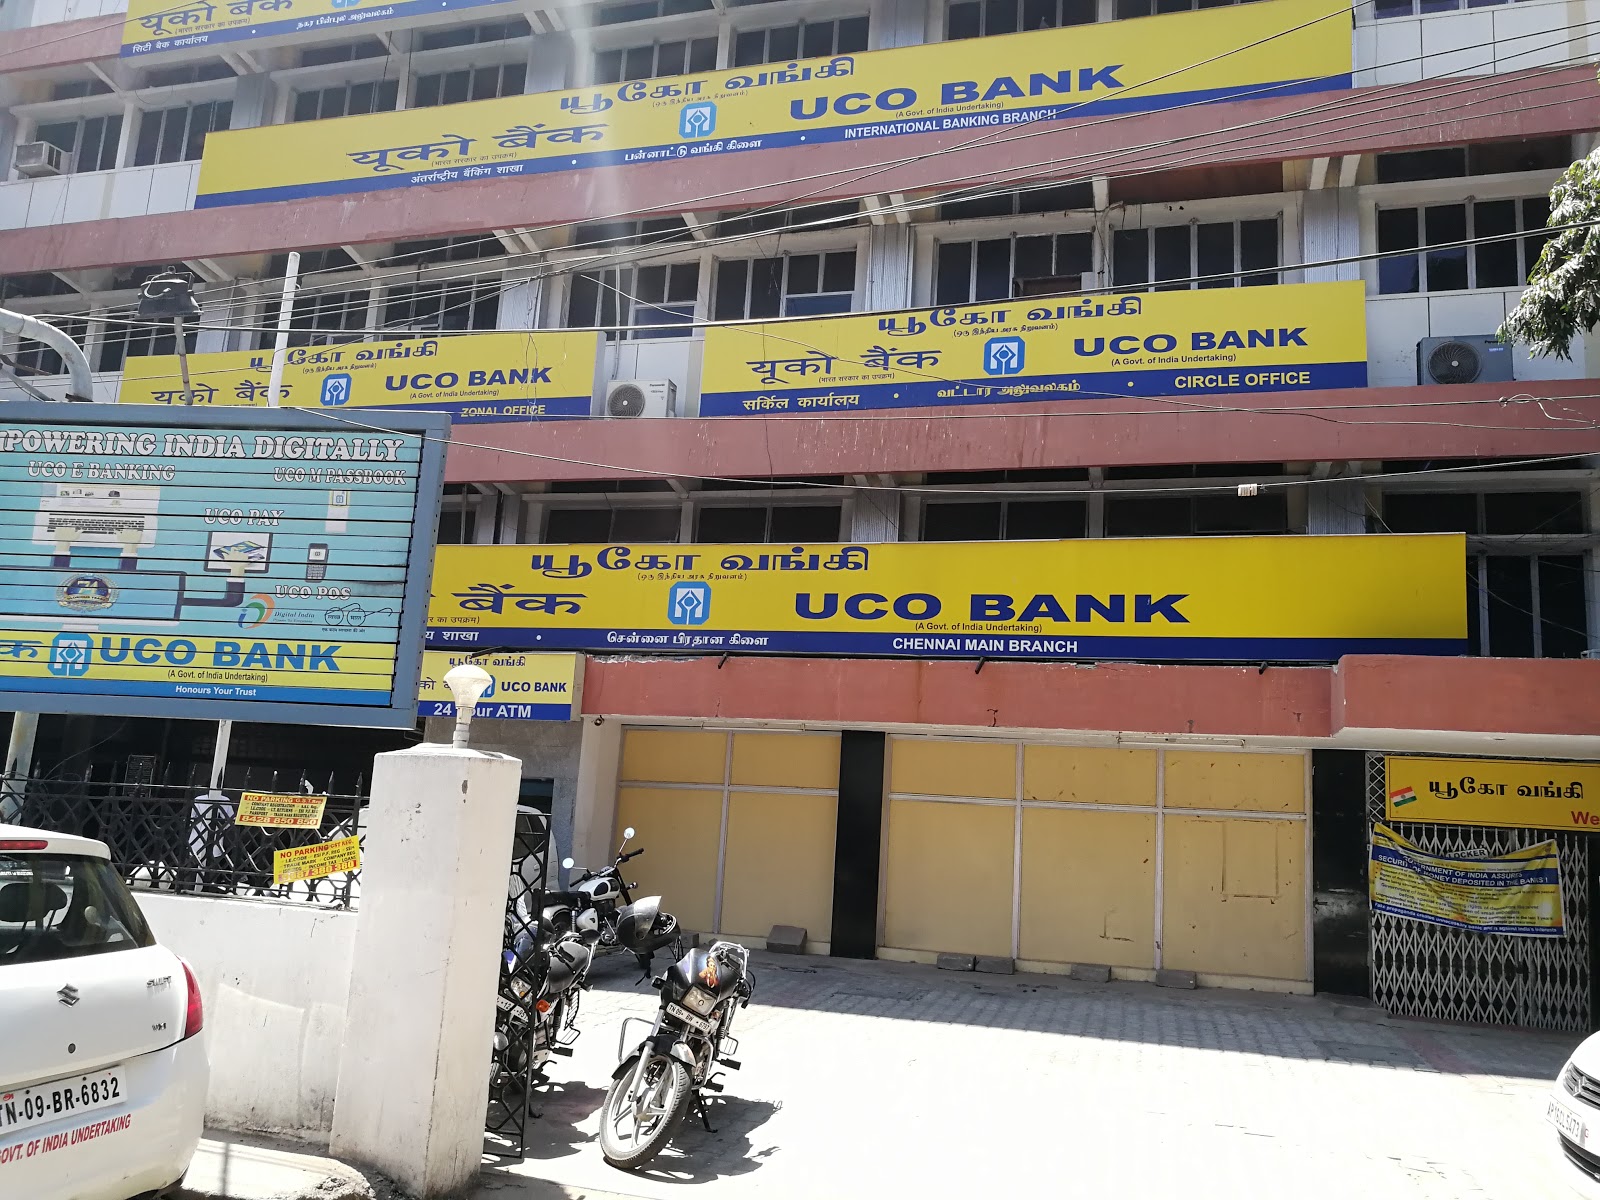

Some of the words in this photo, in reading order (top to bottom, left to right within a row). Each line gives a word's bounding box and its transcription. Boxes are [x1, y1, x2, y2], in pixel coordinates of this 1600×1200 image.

[138, 0, 217, 36] यूको
[132, 42, 152, 54] सिटी
[174, 34, 209, 47] कार्यालय
[560, 78, 708, 114] யூகோ
[724, 56, 855, 90] வங்கி
[790, 87, 918, 120] UCO
[940, 64, 1126, 106] BANK
[895, 110, 905, 119] (A
[906, 108, 926, 118] Govt.
[936, 105, 955, 114] India
[956, 101, 1004, 112] Undertaking)
[844, 120, 940, 140] INTERNATIONAL
[942, 114, 1000, 130] BANKING
[1002, 108, 1057, 124] BRANCH
[346, 134, 478, 172] यूको
[492, 124, 610, 149] बैंक
[624, 144, 688, 162] பன்னாட்டு
[690, 140, 724, 154] வங்கி
[726, 138, 762, 152] கிளை
[496, 164, 524, 174] शाखा
[878, 306, 1013, 337] யூகோ
[1027, 296, 1142, 321] வங்கி
[355, 340, 438, 362] வங்கி
[1073, 333, 1178, 357] UCO
[1191, 326, 1309, 352] BANK
[746, 350, 840, 385] यूको
[860, 344, 942, 371] बैंक
[1111, 357, 1122, 368] (A
[1122, 356, 1146, 367] Govt.
[1146, 356, 1157, 365] of
[1158, 355, 1180, 364] India
[1180, 352, 1237, 364] Undertaking)
[385, 372, 459, 392] UCO
[467, 366, 553, 387] BANK
[1174, 372, 1241, 390] CIRCLE
[1244, 370, 1312, 387] OFFICE
[410, 391, 418, 400] (A
[418, 390, 434, 400] Govt.
[434, 390, 443, 398] of
[443, 390, 458, 398] India
[459, 388, 500, 398] Undertaking)
[798, 391, 860, 408] कार्यालय
[460, 406, 498, 418] ZONAL
[502, 404, 546, 416] OFFICE
[162, 434, 246, 458] INDIA
[252, 436, 404, 462] DIGITALLY
[28, 461, 67, 478] UCO
[72, 462, 84, 478] E
[88, 462, 176, 481] BANKING
[274, 467, 306, 483] UCO
[309, 468, 322, 484] M
[325, 468, 406, 486] PASSBOOK
[204, 508, 244, 524] UCO
[247, 510, 284, 526] PAY
[530, 546, 702, 579] யூகோ
[720, 545, 868, 572] வங்கி
[274, 584, 312, 599] UCO
[316, 586, 352, 600] POS
[451, 583, 589, 615] बैंक
[274, 611, 298, 619] Digital
[794, 592, 942, 620] UCO
[969, 593, 1192, 624] BANK
[442, 630, 480, 642] शाखा
[914, 622, 927, 632] (A
[928, 622, 950, 632] Govt.
[950, 622, 960, 632] of
[962, 622, 984, 632] India
[985, 622, 1043, 634] Undertaking)
[606, 630, 670, 647] சென்னை
[672, 631, 726, 649] பிரதான
[728, 632, 770, 647] கிளை
[892, 638, 961, 652] CHENNAI
[965, 638, 1006, 652] MAIN
[1008, 639, 1078, 654] BRANCH
[100, 636, 197, 666] UCO
[212, 641, 342, 672] BANK
[492, 655, 526, 667] வங்கி
[168, 669, 176, 680] (A
[178, 670, 196, 679] Govt.
[198, 670, 205, 679] of
[206, 671, 223, 680] India
[224, 672, 268, 683] Undertaking)
[175, 684, 212, 694] Honours
[213, 686, 232, 696] Your
[234, 687, 257, 696] Trust
[501, 681, 531, 692] UCO
[534, 682, 568, 693] BANK
[434, 702, 453, 716] 24
[495, 705, 532, 718] ATM
[1429, 776, 1508, 800] யூகோ
[1517, 780, 1584, 800] வங்கி
[280, 852, 292, 860] NO
[294, 844, 330, 857] PARKING
[1452, 876, 1495, 886] DEPOSITED
[26, 1140, 41, 1158] OF
[42, 1132, 68, 1153] INDIA
[71, 1114, 132, 1146] UNDERTAKING
